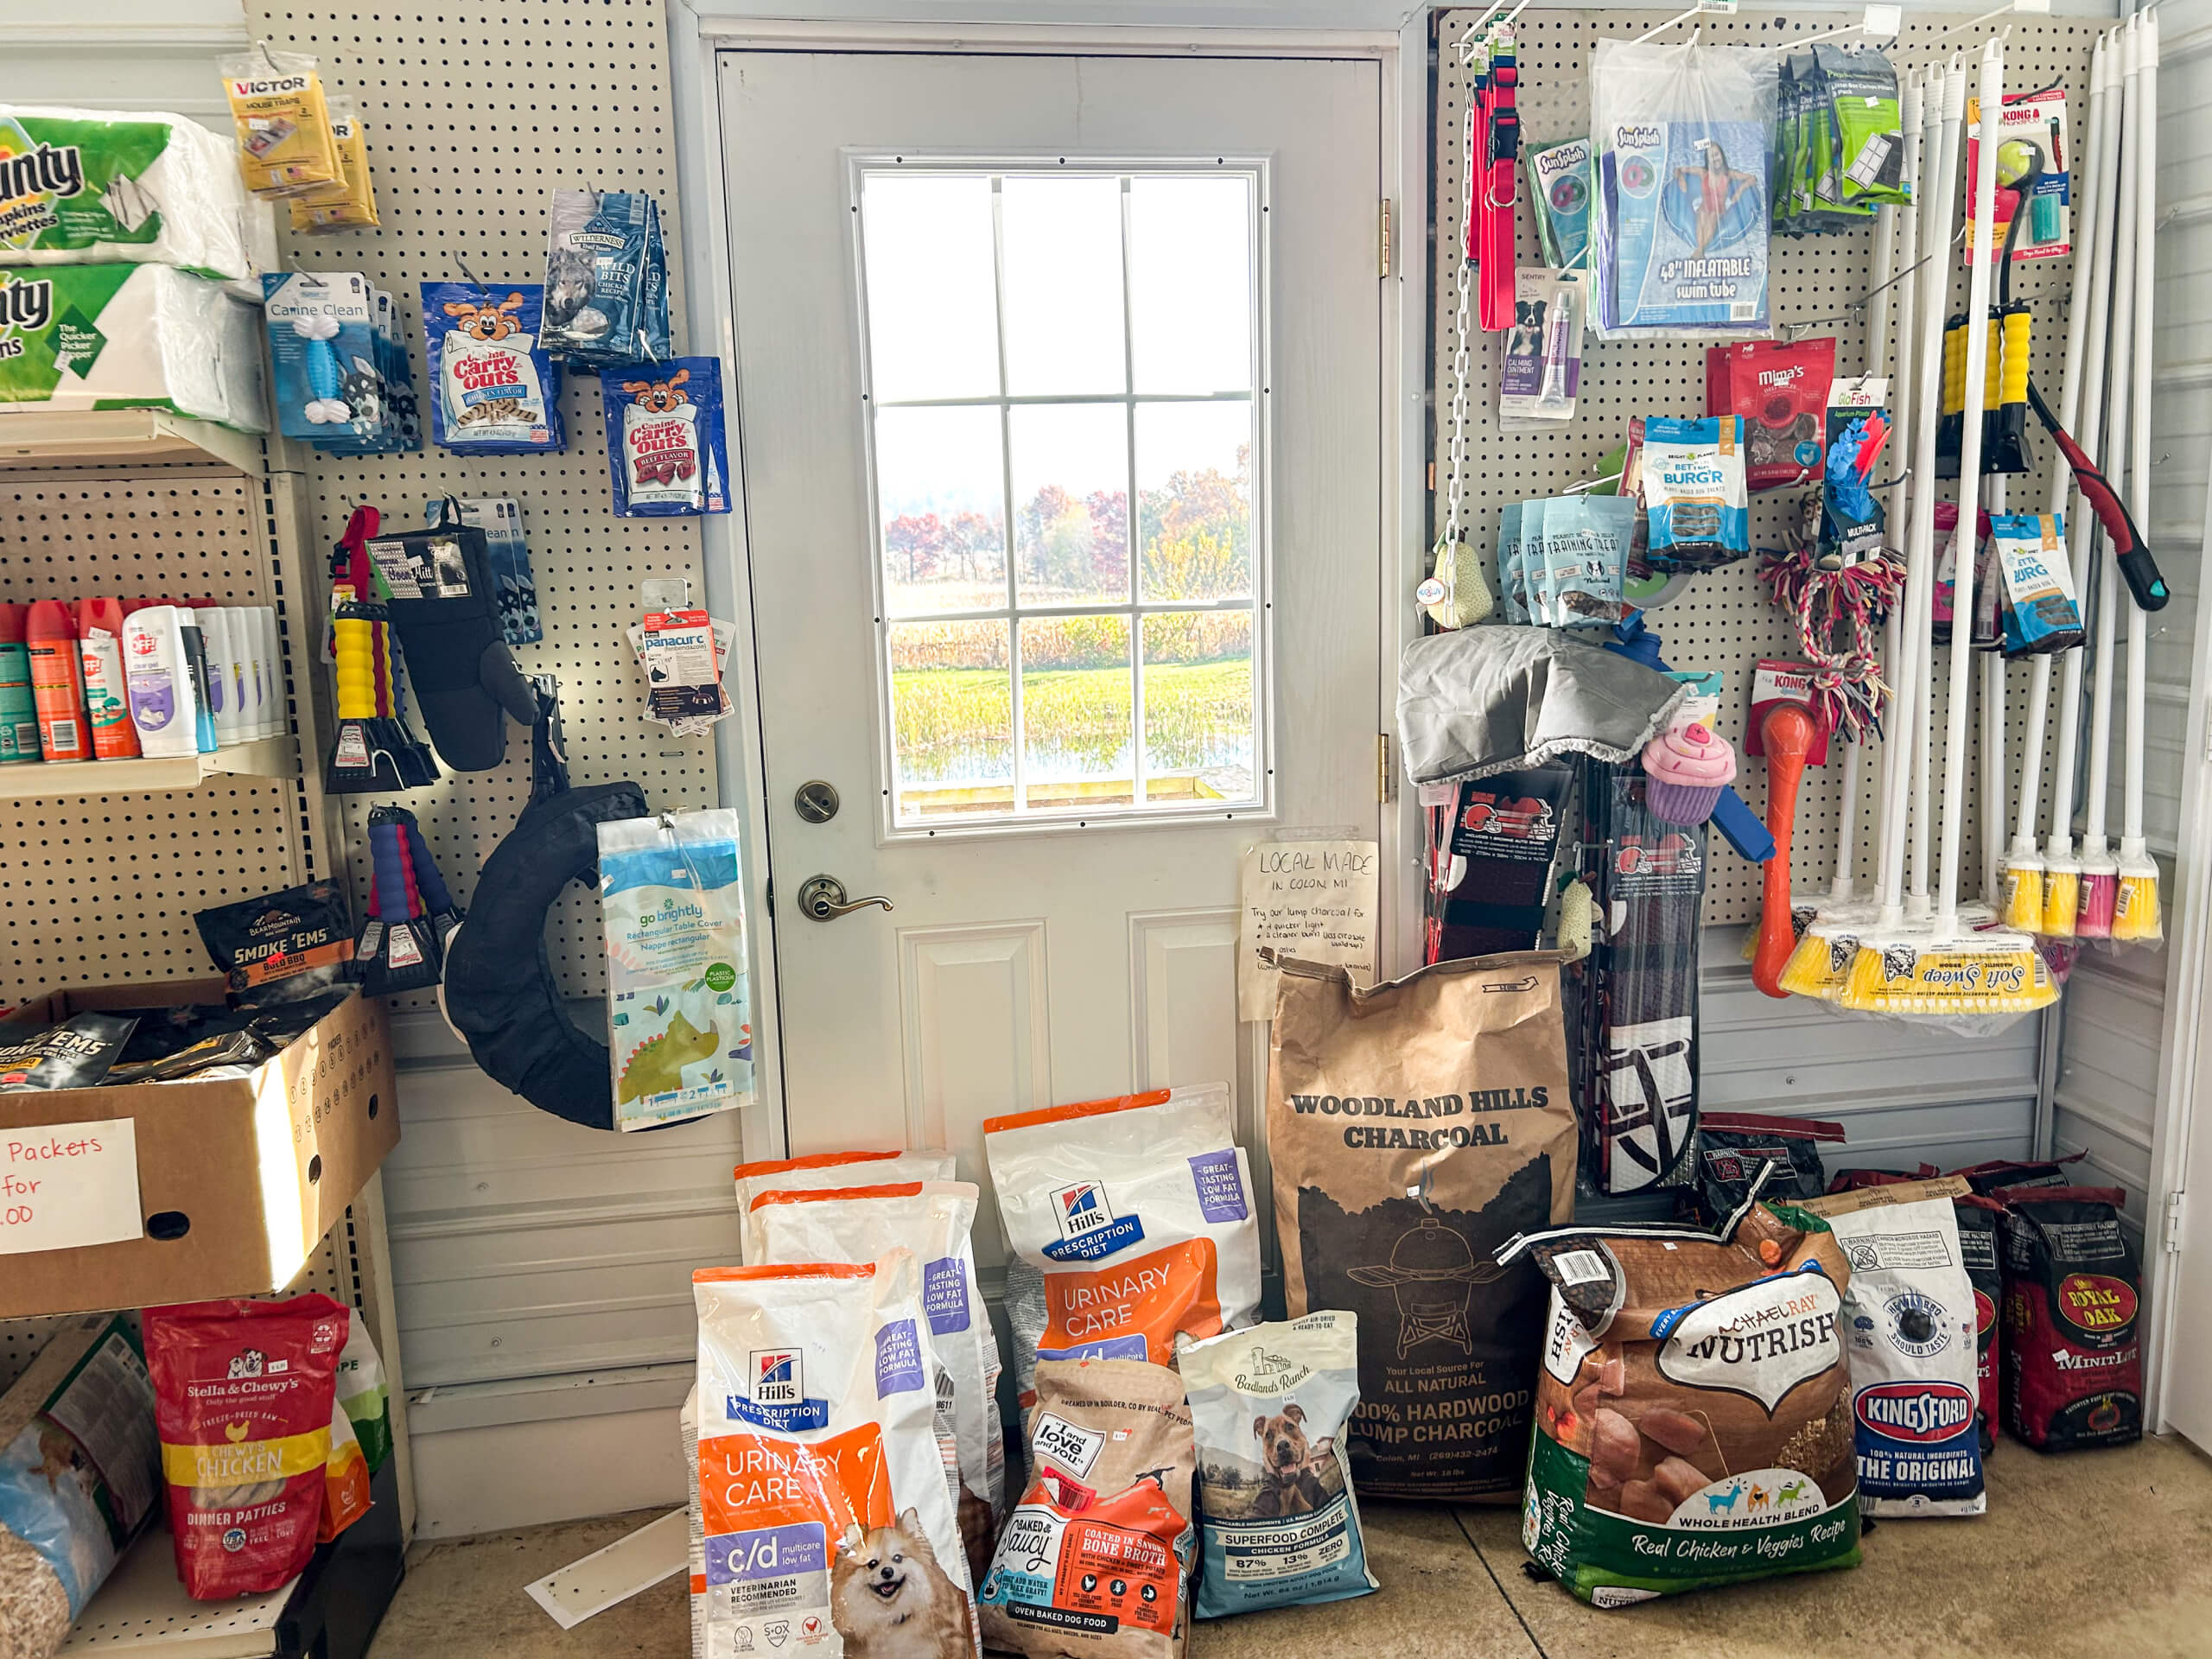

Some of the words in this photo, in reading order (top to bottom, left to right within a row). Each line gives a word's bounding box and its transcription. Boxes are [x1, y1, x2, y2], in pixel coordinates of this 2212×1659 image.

[237, 77, 305, 95] VICTOR
[246, 99, 274, 109] MOUSE
[2003, 109, 2031, 120] KONG
[1618, 126, 1661, 149] SunSplash
[1541, 146, 1586, 175] SunSplash
[573, 234, 624, 247] WILDERNESS
[1683, 257, 1751, 278] INFLATABLE
[601, 271, 630, 284] BITS
[1676, 280, 1707, 299] swim
[1709, 279, 1736, 297] tube
[271, 304, 318, 316] Canine
[323, 304, 363, 316] Clean
[59, 323, 78, 333] The
[60, 341, 92, 350] Picker
[454, 355, 518, 379] Carry
[1507, 365, 1535, 374] OINTMENT
[1508, 359, 1533, 367] CALMING
[1839, 391, 1871, 405] GloFish
[641, 419, 676, 430] Canine
[630, 423, 686, 445] Carry
[660, 453, 689, 461] FLAVOR
[1548, 538, 1592, 554] TRAINING
[645, 636, 695, 651] panacur
[1774, 675, 1807, 690] KONG
[1260, 851, 1315, 874] LOCAL
[1324, 850, 1373, 875] MADE
[1272, 880, 1283, 891] IN
[1333, 879, 1348, 888] MI
[640, 914, 655, 927] go
[657, 903, 703, 922] brightly
[1251, 907, 1267, 921] Try
[1287, 907, 1307, 918] lump
[1311, 906, 1351, 917] charcoal
[1353, 909, 1364, 918] for
[626, 926, 672, 940] Rectangular
[1272, 931, 1299, 939] cleaner
[1274, 922, 1300, 932] quicker
[234, 938, 288, 964] SMOKE
[641, 939, 666, 950] Nappe
[706, 974, 734, 982] PLASTIQUE
[1923, 965, 1980, 991] Sweep
[1985, 965, 2025, 993] Soft
[1290, 1094, 1463, 1119] WOODLAND
[1469, 1086, 1549, 1113] HILLS
[1344, 1123, 1509, 1150] CHARCOAL
[8, 1137, 104, 1162] Packets
[2, 1174, 41, 1197] for
[1201, 1173, 1234, 1184] TASTING
[1202, 1184, 1222, 1195] LOW
[1223, 1183, 1237, 1192] FAT
[1205, 1193, 1241, 1205] FORMULA
[1051, 1222, 1135, 1258] PRESCRIPTION
[1847, 1236, 1875, 1245] WARNING
[1081, 1243, 1108, 1259] DIET
[929, 1279, 961, 1292] TASTING
[1064, 1263, 1171, 1312] URINARY
[926, 1292, 944, 1303] LOW
[946, 1289, 962, 1300] FAT
[2067, 1289, 2121, 1308] ROYAL
[926, 1300, 963, 1313] FORMULA
[1785, 1294, 1817, 1317] RAY
[1065, 1304, 1133, 1338] CARE
[2082, 1308, 2123, 1326] OAK
[880, 1339, 912, 1356] TASTING
[1891, 1332, 1923, 1355] SHOULD
[1925, 1332, 1948, 1354] TASTE
[879, 1354, 897, 1368] LOW
[899, 1349, 916, 1360] FAT
[880, 1361, 918, 1376] FORMULA
[1385, 1365, 1408, 1376] Your
[1409, 1364, 1435, 1376] Local
[1436, 1362, 1468, 1375] Source
[1470, 1360, 1485, 1370] For
[1235, 1374, 1279, 1394] Badlands
[1279, 1364, 1310, 1390] Ranch
[1384, 1380, 1414, 1394] ALL
[1417, 1371, 1487, 1391] NATURAL
[188, 1384, 225, 1397] Stella
[227, 1383, 239, 1394] &
[242, 1378, 298, 1394] Chewy's
[735, 1402, 820, 1418] PRESCRIPTION
[1407, 1389, 1529, 1421] HARDWOOD
[1866, 1392, 1968, 1434] KINGSFORD
[762, 1417, 790, 1429] DIET
[1164, 1410, 1176, 1421] PET
[1413, 1414, 1523, 1443] CHARCOAL
[1034, 1440, 1053, 1449] and
[1039, 1424, 1083, 1455] love
[1065, 1432, 1087, 1446] and
[1376, 1452, 1405, 1463] Colon,
[1407, 1452, 1420, 1461] MI
[1870, 1448, 1892, 1459] 100%
[1894, 1451, 1926, 1460] NATURAL
[1927, 1449, 1967, 1460] INGREDIENTS
[196, 1448, 283, 1478] CHICKEN
[726, 1448, 842, 1477] URINARY
[1858, 1455, 1891, 1480] THE
[1896, 1457, 1976, 1482] ORIGINAL
[726, 1478, 801, 1507] CARE
[187, 1512, 232, 1526] DINNER
[236, 1502, 286, 1524] PATTIES
[1679, 1518, 1729, 1529] WHOLE
[1732, 1515, 1780, 1528] HEALTH
[1783, 1503, 1820, 1522] BLEND
[1017, 1519, 1043, 1532] BAKED
[1043, 1522, 1052, 1533] &
[1225, 1532, 1298, 1545] SUPERFOOD
[1300, 1510, 1344, 1539] COMPLETE
[1084, 1528, 1121, 1543] COATED
[1123, 1535, 1134, 1545] IN
[1251, 1546, 1292, 1554] CHICKEN
[1294, 1533, 1330, 1551] FORMULA
[1631, 1534, 1669, 1557] Real
[1676, 1539, 1736, 1561] Chicken
[1757, 1535, 1804, 1558] Veggies
[1811, 1518, 1846, 1542] Recipe
[728, 1536, 778, 1573] c/d
[781, 1541, 821, 1555] multicare
[1082, 1537, 1120, 1556] BONE
[1123, 1545, 1167, 1567] BROTH
[1318, 1538, 1344, 1555] ZERO
[781, 1556, 797, 1567] low
[798, 1554, 811, 1564] fat
[1096, 1554, 1121, 1566] CHICKEN
[1236, 1559, 1267, 1568] 87%
[1282, 1554, 1308, 1565] 13%
[730, 1579, 797, 1595] VETERINARIAN
[1015, 1576, 1027, 1586] ADD
[1028, 1578, 1048, 1588] WATER
[731, 1587, 797, 1604] RECOMMENDED
[1014, 1606, 1035, 1618] OVEN
[1036, 1609, 1063, 1622] BAKED
[1065, 1614, 1082, 1624] DOG
[1084, 1618, 1107, 1628] FOOD
